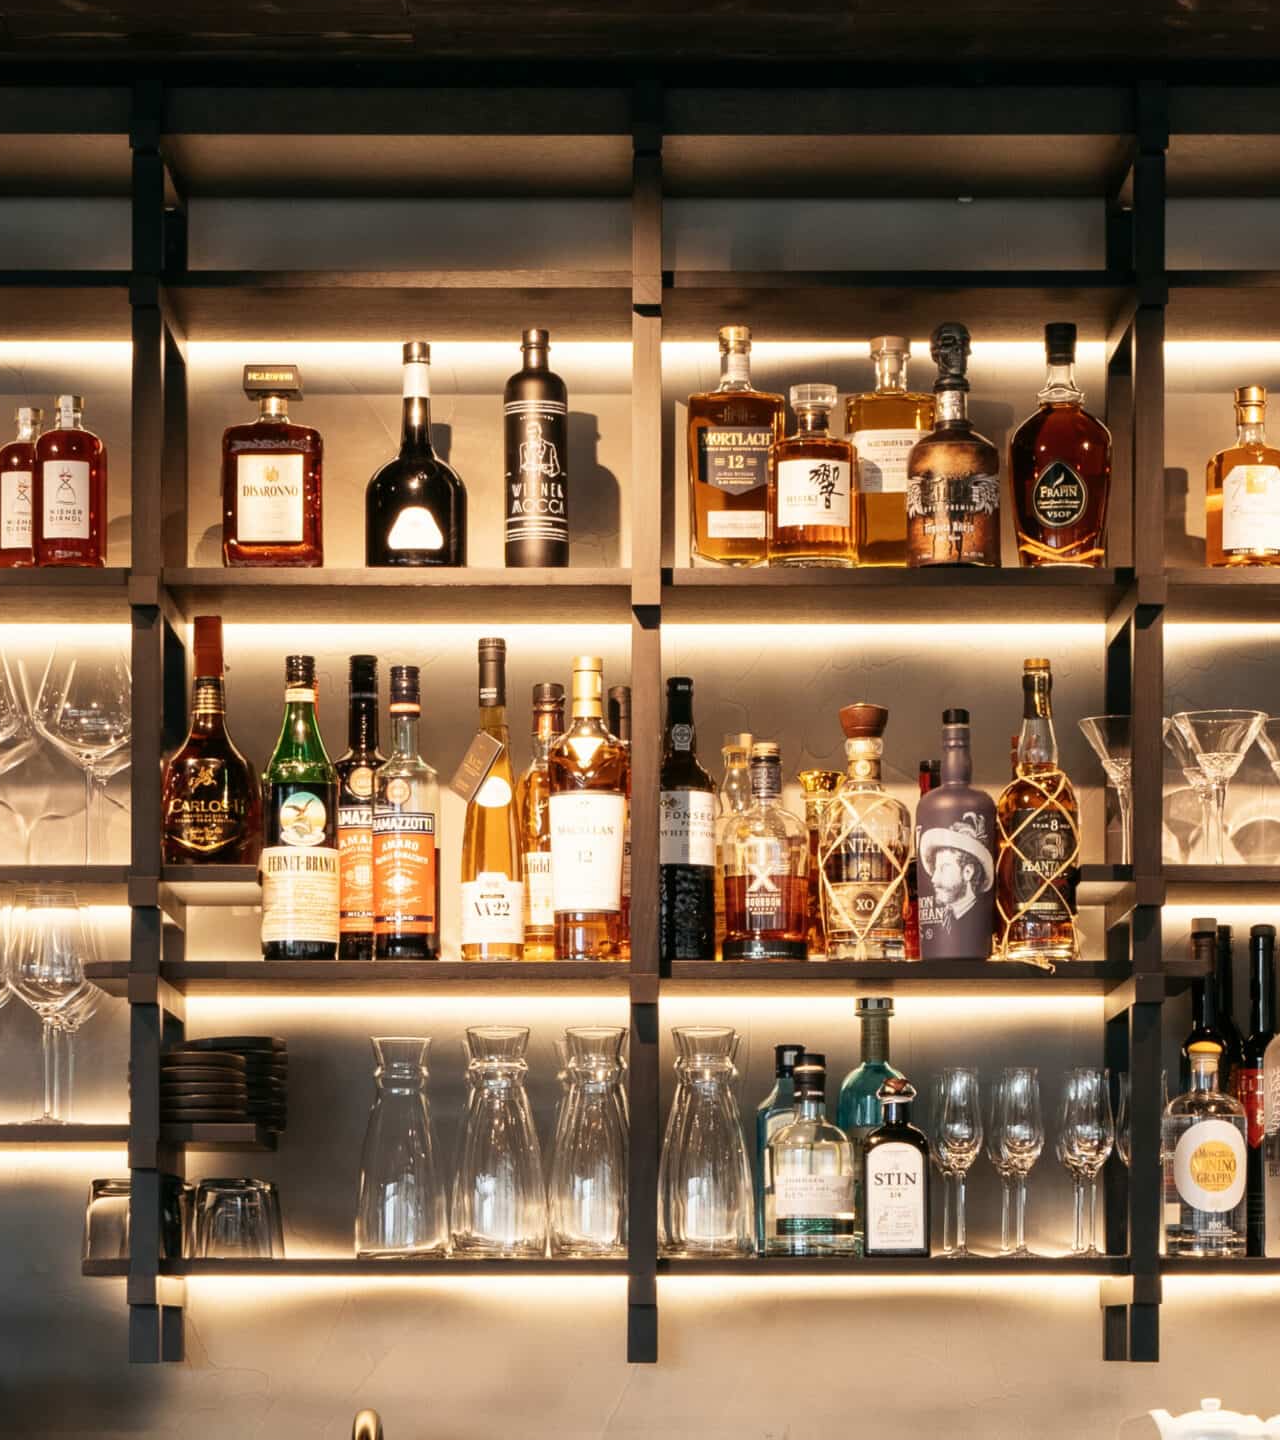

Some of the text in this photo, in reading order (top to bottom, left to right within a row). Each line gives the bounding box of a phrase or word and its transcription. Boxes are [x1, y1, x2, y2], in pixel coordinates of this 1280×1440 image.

[703, 432, 770, 447] MORTLACH
[727, 454, 745, 470] 12
[242, 485, 298, 497] DISARONNO
[1039, 484, 1078, 498] FRAPIN
[1046, 510, 1071, 519] VSOP
[168, 798, 230, 816] CARLOS
[1050, 819, 1059, 831] 8
[855, 898, 875, 911] XO
[873, 1172, 918, 1186] STIN
[1196, 1172, 1234, 1184] GRAPPA
